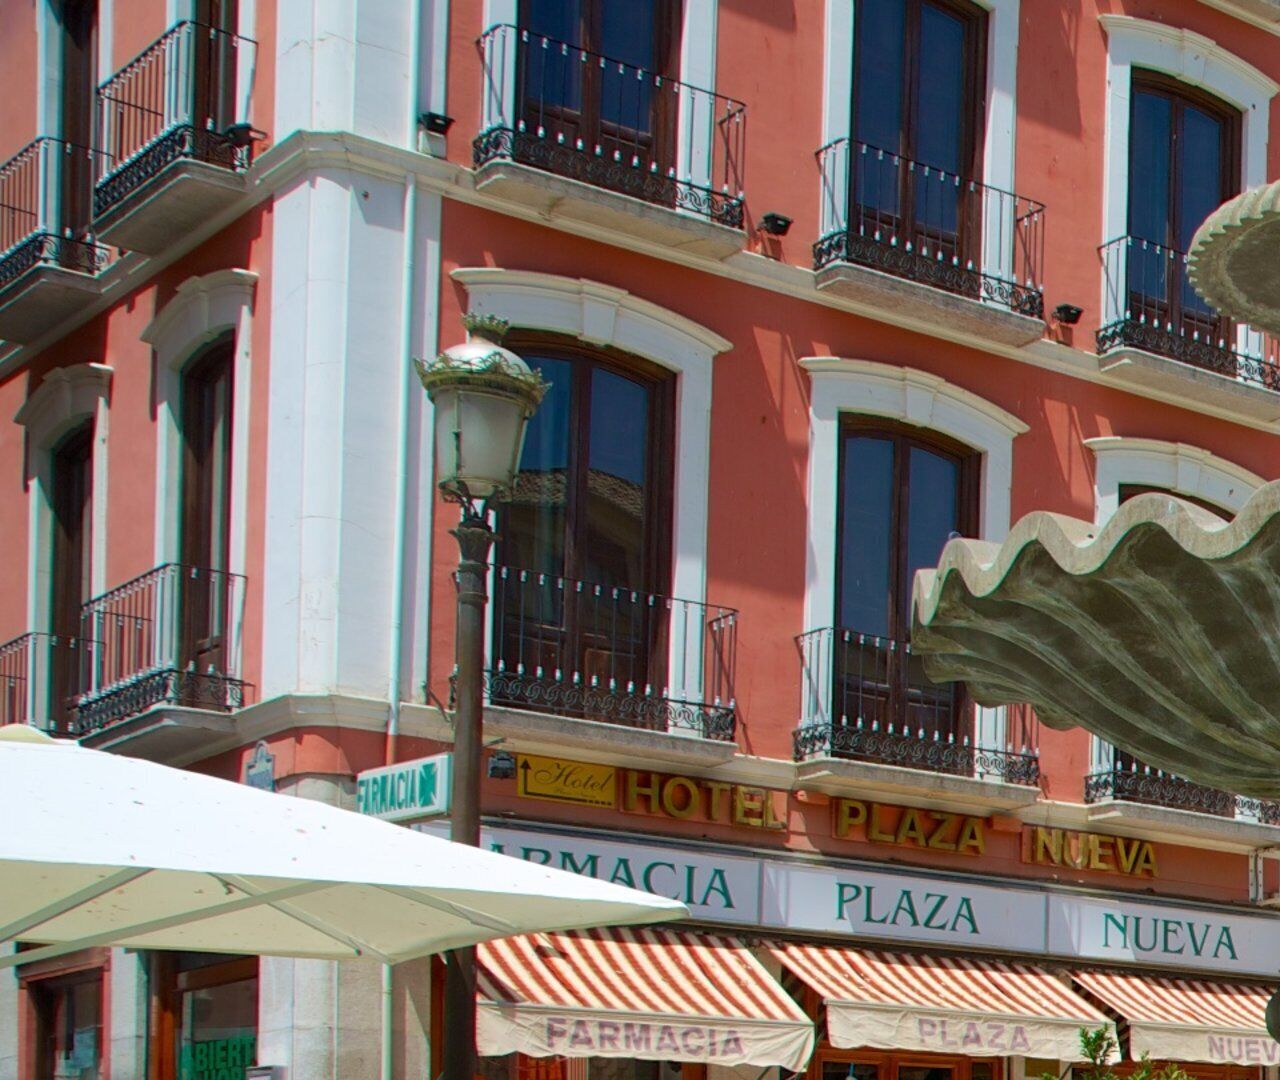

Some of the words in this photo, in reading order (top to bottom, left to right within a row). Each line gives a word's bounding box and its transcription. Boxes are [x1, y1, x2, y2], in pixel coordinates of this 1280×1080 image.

[534, 763, 613, 792] Hotel
[627, 770, 788, 832] HOTEL
[839, 800, 986, 855] PLAZA
[1036, 827, 1160, 878] NUEVA
[835, 882, 981, 935] PLAZA
[1101, 912, 1240, 961] NUEVA
[181, 1035, 256, 1073] ABIERT
[546, 1017, 746, 1057] FARMACIA
[918, 1018, 1032, 1053] PLAZA
